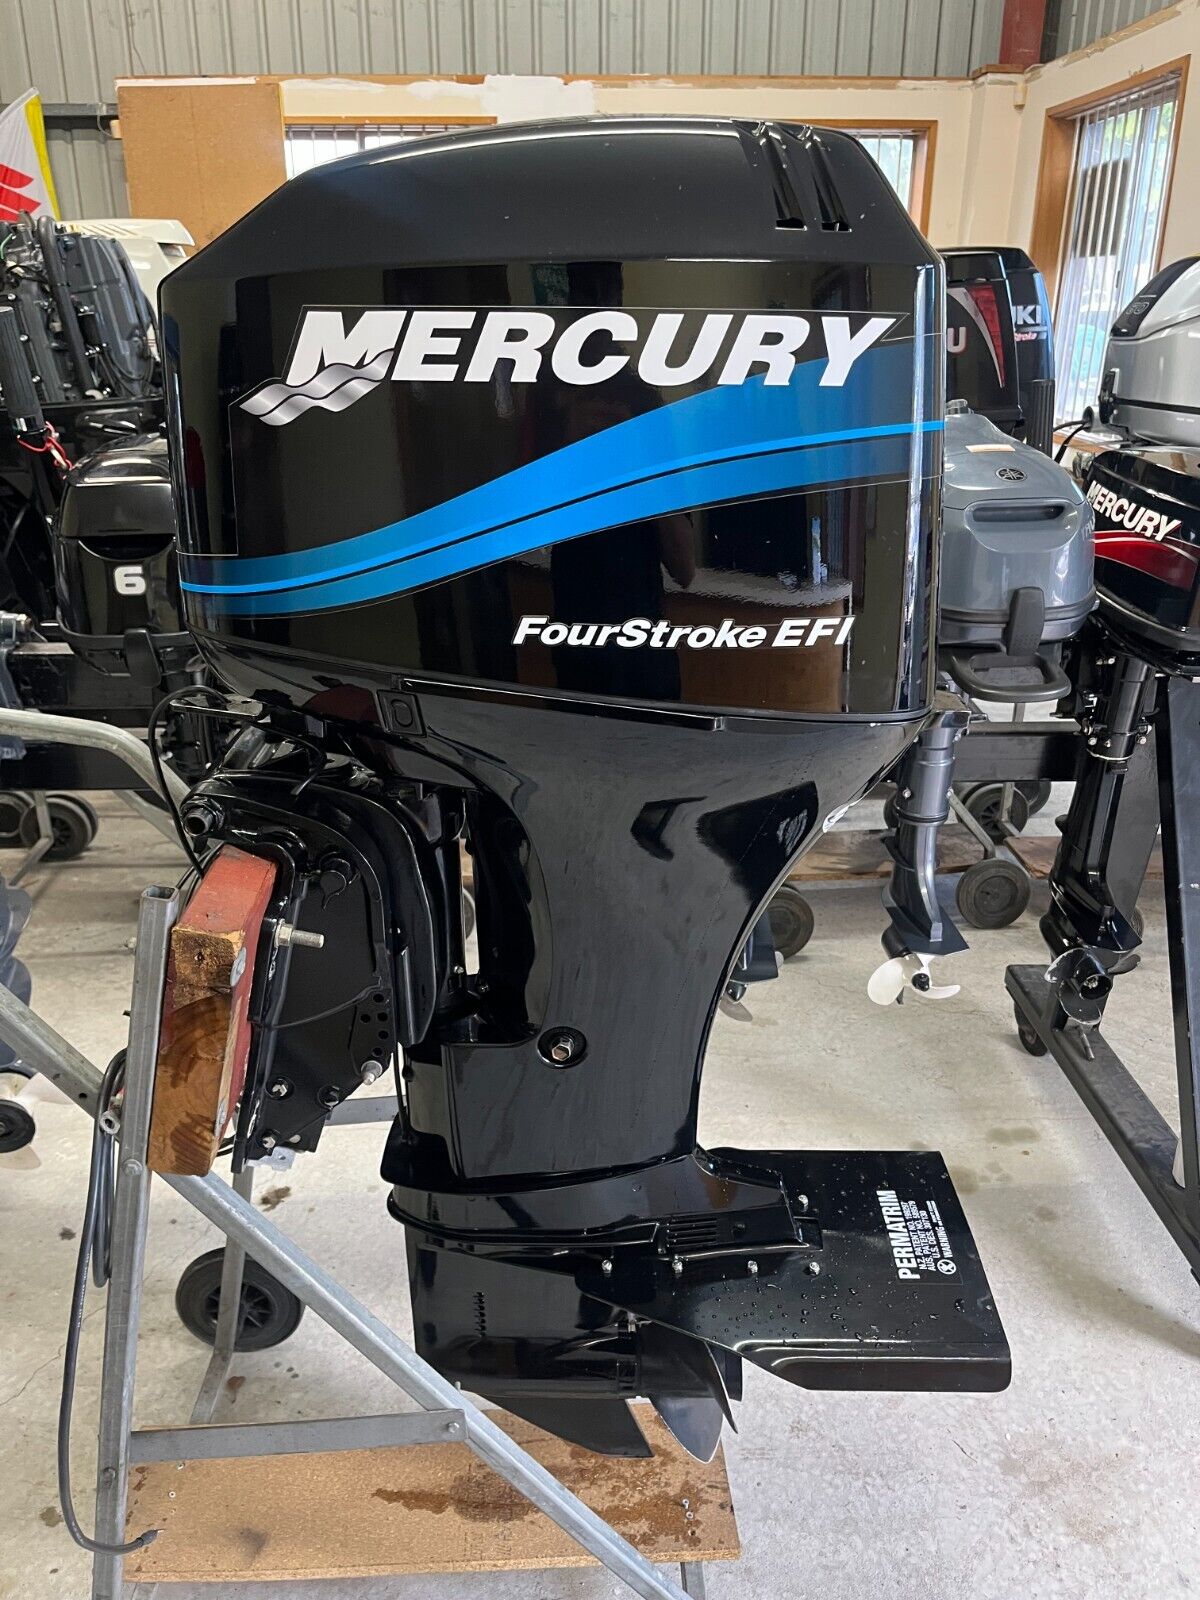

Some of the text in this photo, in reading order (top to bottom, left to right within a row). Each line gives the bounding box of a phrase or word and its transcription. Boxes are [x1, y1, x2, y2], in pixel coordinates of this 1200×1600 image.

[285, 310, 897, 387] MERCURY
[1086, 480, 1182, 541] MERCURY
[114, 566, 146, 595] 6
[512, 617, 856, 648] FourStroke EFI
[876, 1190, 921, 1279] PERMATRIM
[919, 1210, 932, 1230] 307130
[909, 1230, 924, 1256] PATENT
[916, 1229, 932, 1255] PATENT
[935, 1226, 953, 1258] WARNING
[924, 1256, 937, 1271] AUS.
